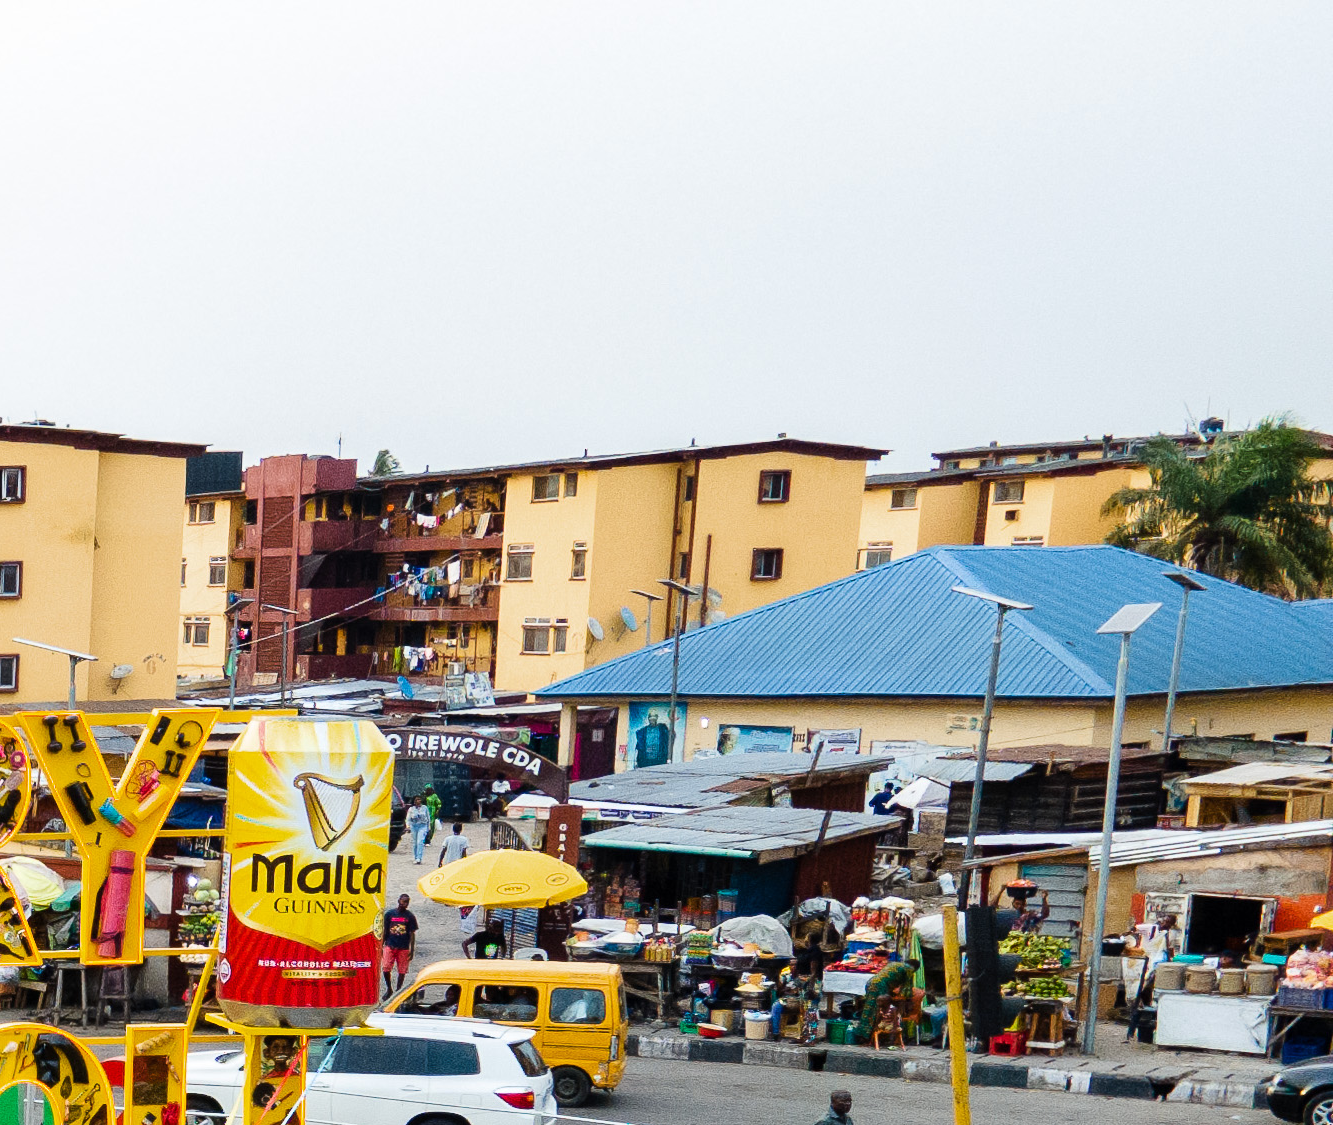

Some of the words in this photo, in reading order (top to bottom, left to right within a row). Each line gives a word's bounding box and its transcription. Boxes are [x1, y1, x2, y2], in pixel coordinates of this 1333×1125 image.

[408, 733, 500, 759] IREWOLE
[501, 746, 542, 777] CDA
[251, 853, 382, 895] Malta
[273, 897, 365, 915] GUINNESS
